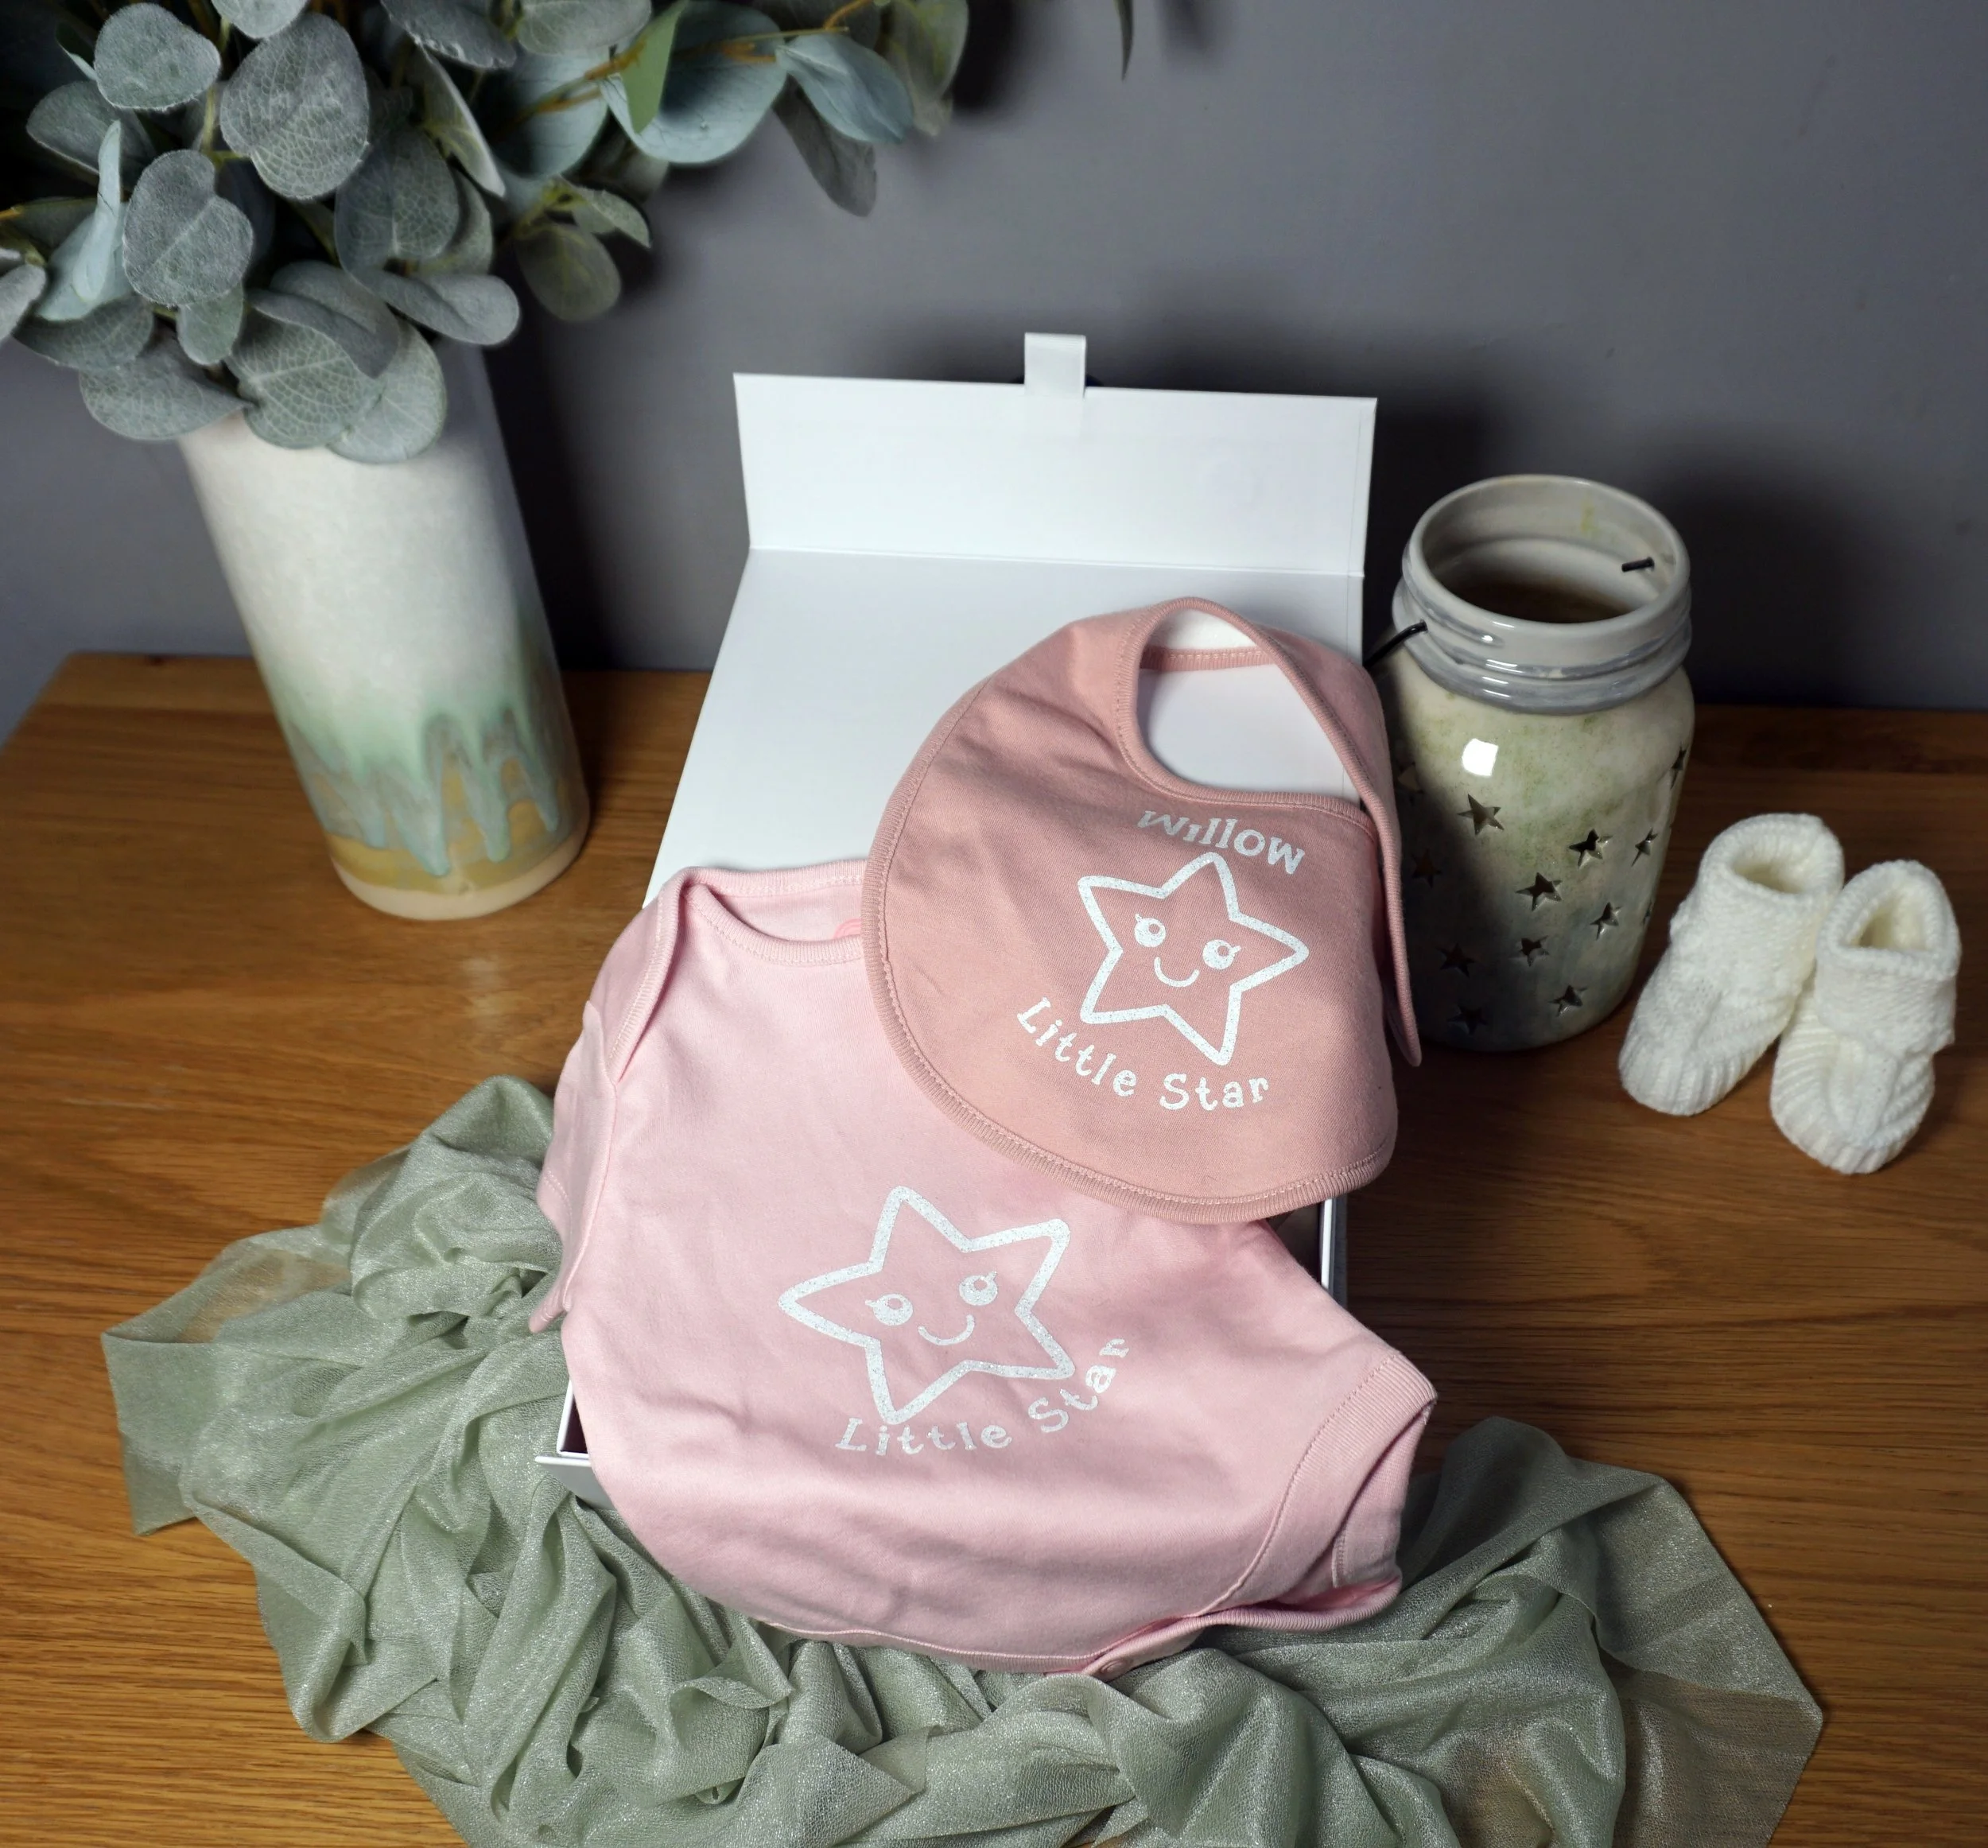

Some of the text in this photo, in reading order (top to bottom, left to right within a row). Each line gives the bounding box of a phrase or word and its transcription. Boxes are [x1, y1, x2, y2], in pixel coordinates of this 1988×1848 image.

[1016, 996, 1269, 1111] Little Star
[834, 1337, 1129, 1456] Little Star
